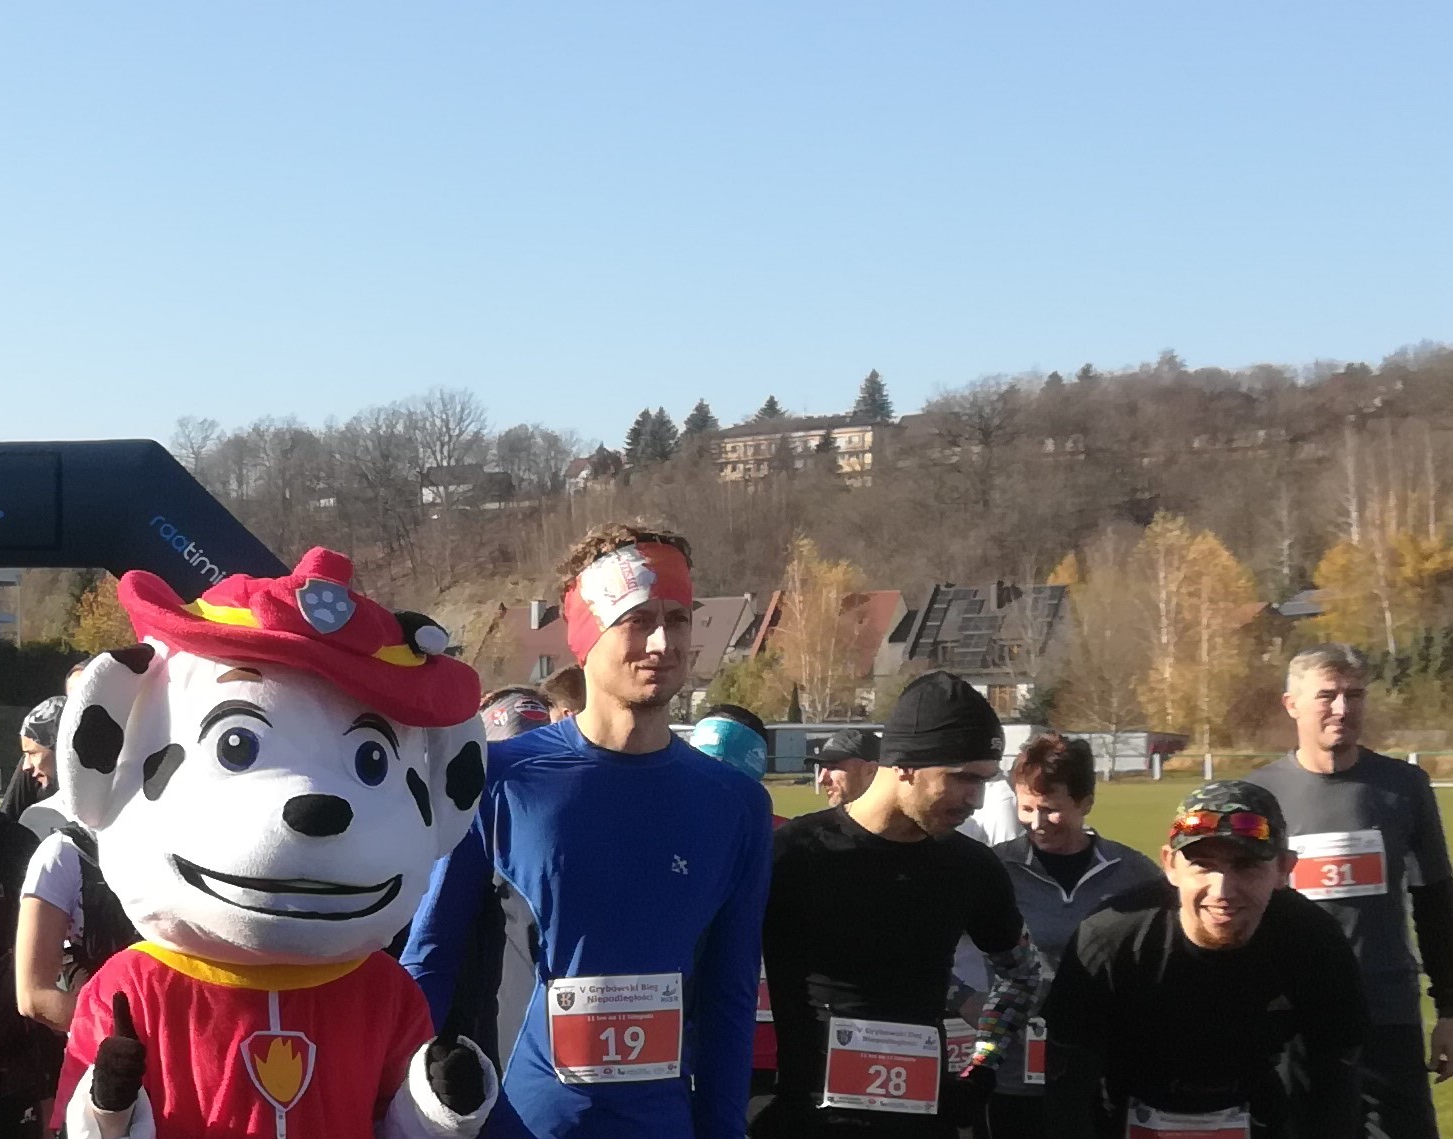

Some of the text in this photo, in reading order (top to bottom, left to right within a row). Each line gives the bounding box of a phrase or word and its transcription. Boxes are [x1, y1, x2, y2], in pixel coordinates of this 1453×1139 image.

[1320, 863, 1357, 886] 31
[599, 1026, 645, 1062] 19
[865, 1064, 907, 1097] 28
